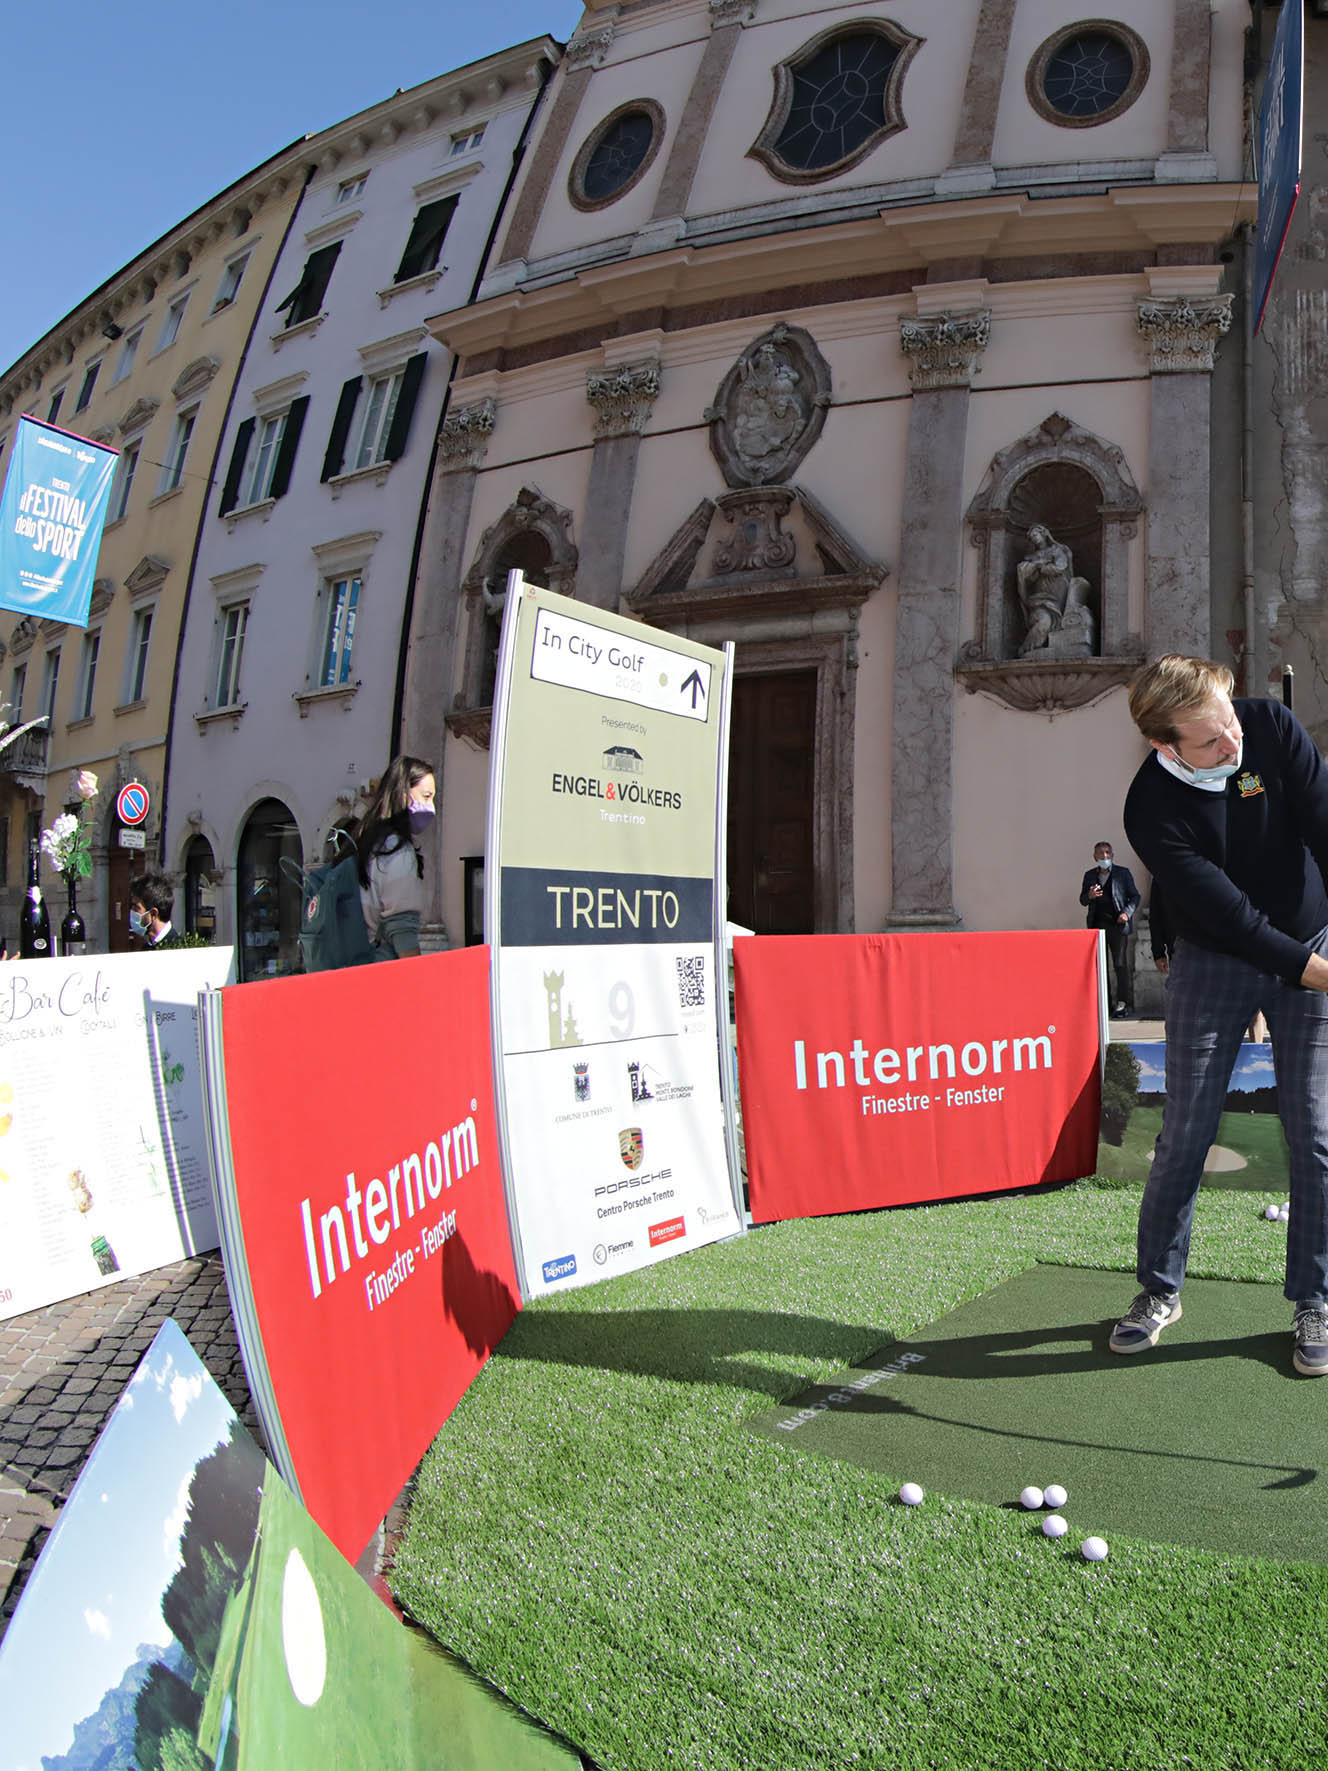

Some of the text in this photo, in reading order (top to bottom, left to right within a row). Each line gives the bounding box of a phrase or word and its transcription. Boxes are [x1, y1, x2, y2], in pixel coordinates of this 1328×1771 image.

[25, 483, 87, 531] FESTIVAL
[14, 514, 85, 561] dello SPORT
[541, 627, 645, 673] In City Golf
[601, 715, 648, 735] Presented by
[551, 774, 682, 810] ENGEL&VÖLKERS
[599, 808, 646, 826] Trentino
[546, 886, 680, 930] TRENTO
[10, 976, 53, 1023] Bar
[608, 980, 636, 1041] 9
[554, 1105, 613, 1124] COMUNE DI TRENTO
[862, 1092, 930, 1116] Finestre
[946, 1084, 1005, 1108] Fenster
[594, 1168, 673, 1198] PORSCHE
[597, 1187, 675, 1219] Centro Porsche Trento
[608, 1239, 634, 1254] Fiemme
[650, 1222, 683, 1239] Internorm
[364, 1238, 417, 1312] Finestre
[422, 1208, 458, 1261] Fenster
[543, 1260, 575, 1279] TRENTINO
